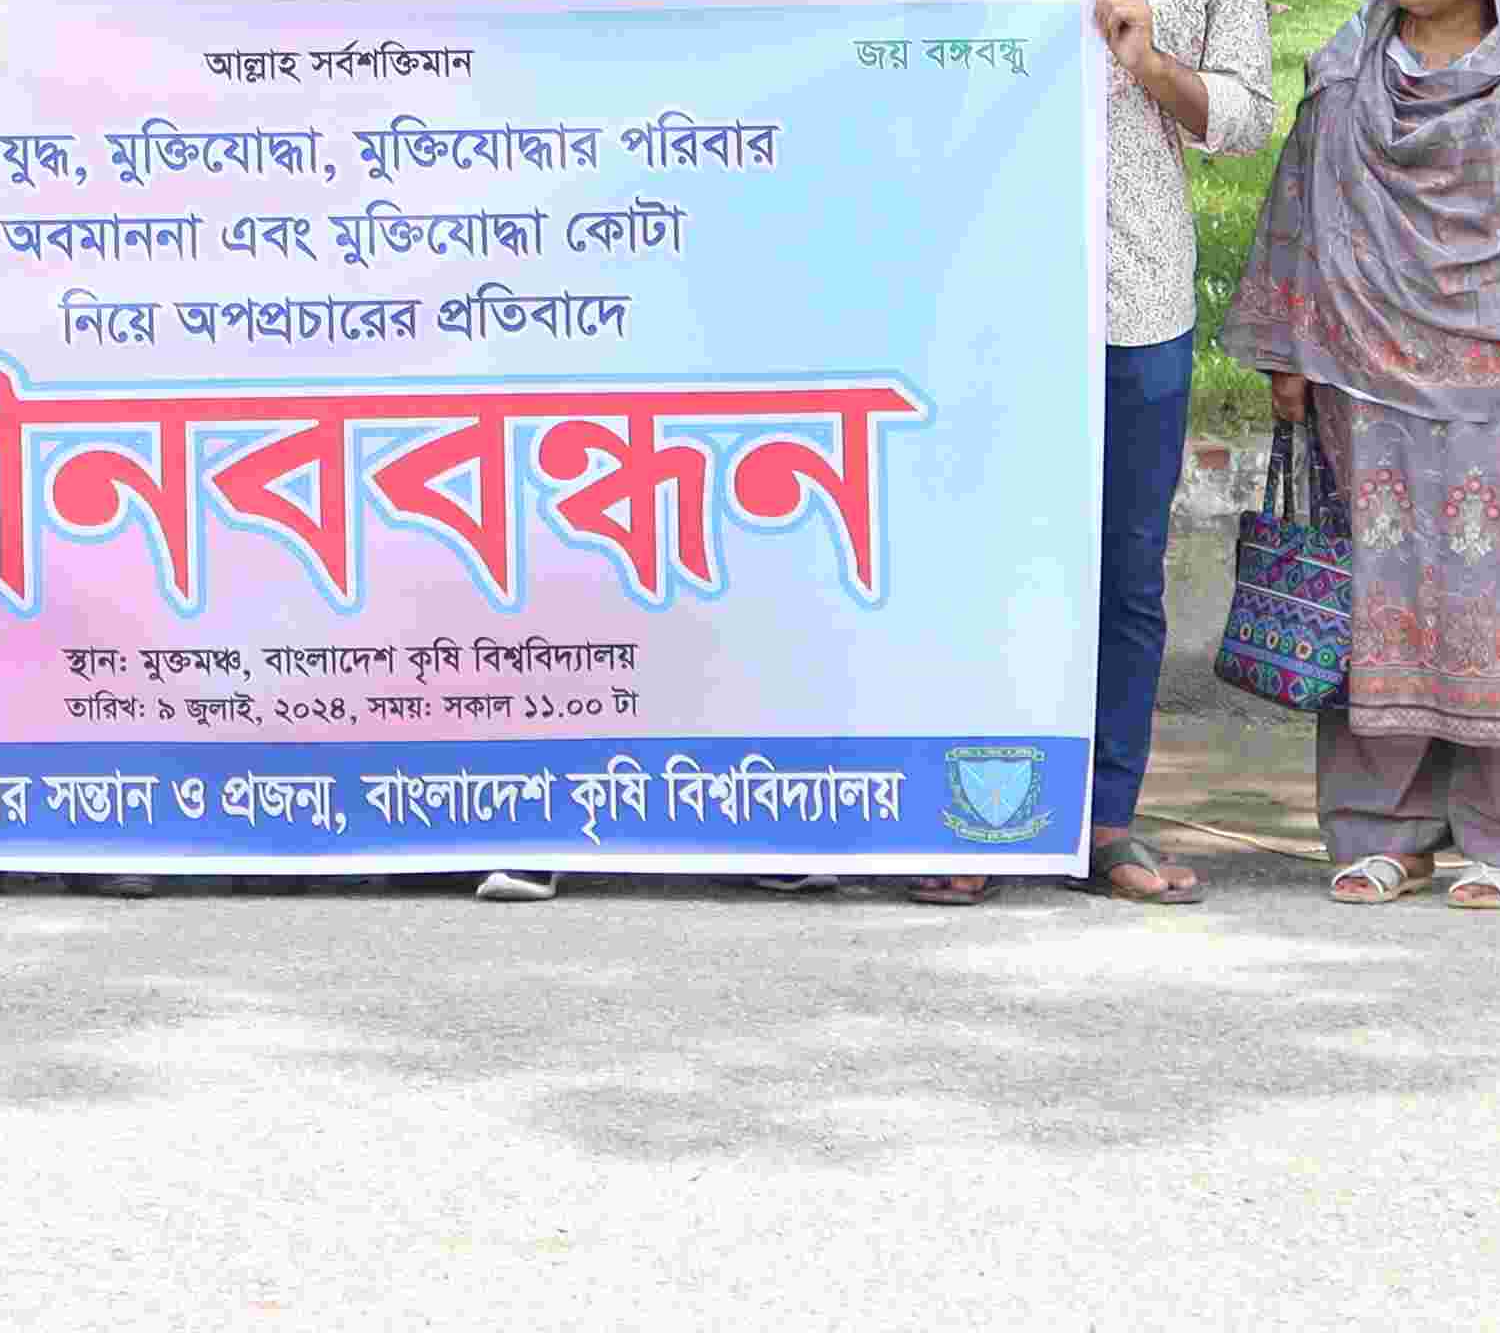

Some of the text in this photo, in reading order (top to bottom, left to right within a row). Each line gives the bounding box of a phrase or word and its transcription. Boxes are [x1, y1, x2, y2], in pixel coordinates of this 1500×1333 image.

[203, 39, 475, 83] আল্লাহ সর্বশক্তিমান
[852, 37, 1031, 77] জয় বঙ্গবন্ধু
[104, 118, 336, 187] মুক্তিযোদ্ধা,
[352, 114, 603, 183] মুক্তিযোদ্ধার
[621, 111, 778, 168] পরিবার
[0, 197, 687, 269] অবমাননা এবং মুক্তিযোদ্ধা কোটা
[58, 282, 631, 345] নিয়ে অপপ্রচারের প্রতিবাদে
[261, 644, 397, 677] বাংলাদেশ
[405, 637, 463, 684] কৃষি
[472, 636, 639, 673] বিশ্ববিদ্যালয়
[158, 697, 177, 721] ৯
[184, 691, 264, 727] জুলাই,
[274, 697, 357, 726] ২০২৪,
[442, 693, 514, 719] সকাল
[524, 694, 603, 719] ১১.০০
[611, 686, 640, 718] টা
[42, 770, 160, 827] সন্তান
[171, 776, 206, 819] ও
[222, 770, 348, 835] প্রজন্ম,
[360, 766, 556, 828] বাংলাদেশ
[566, 755, 652, 845] কৃষি
[662, 753, 906, 825] বিশ্ববিদ্যালয়
